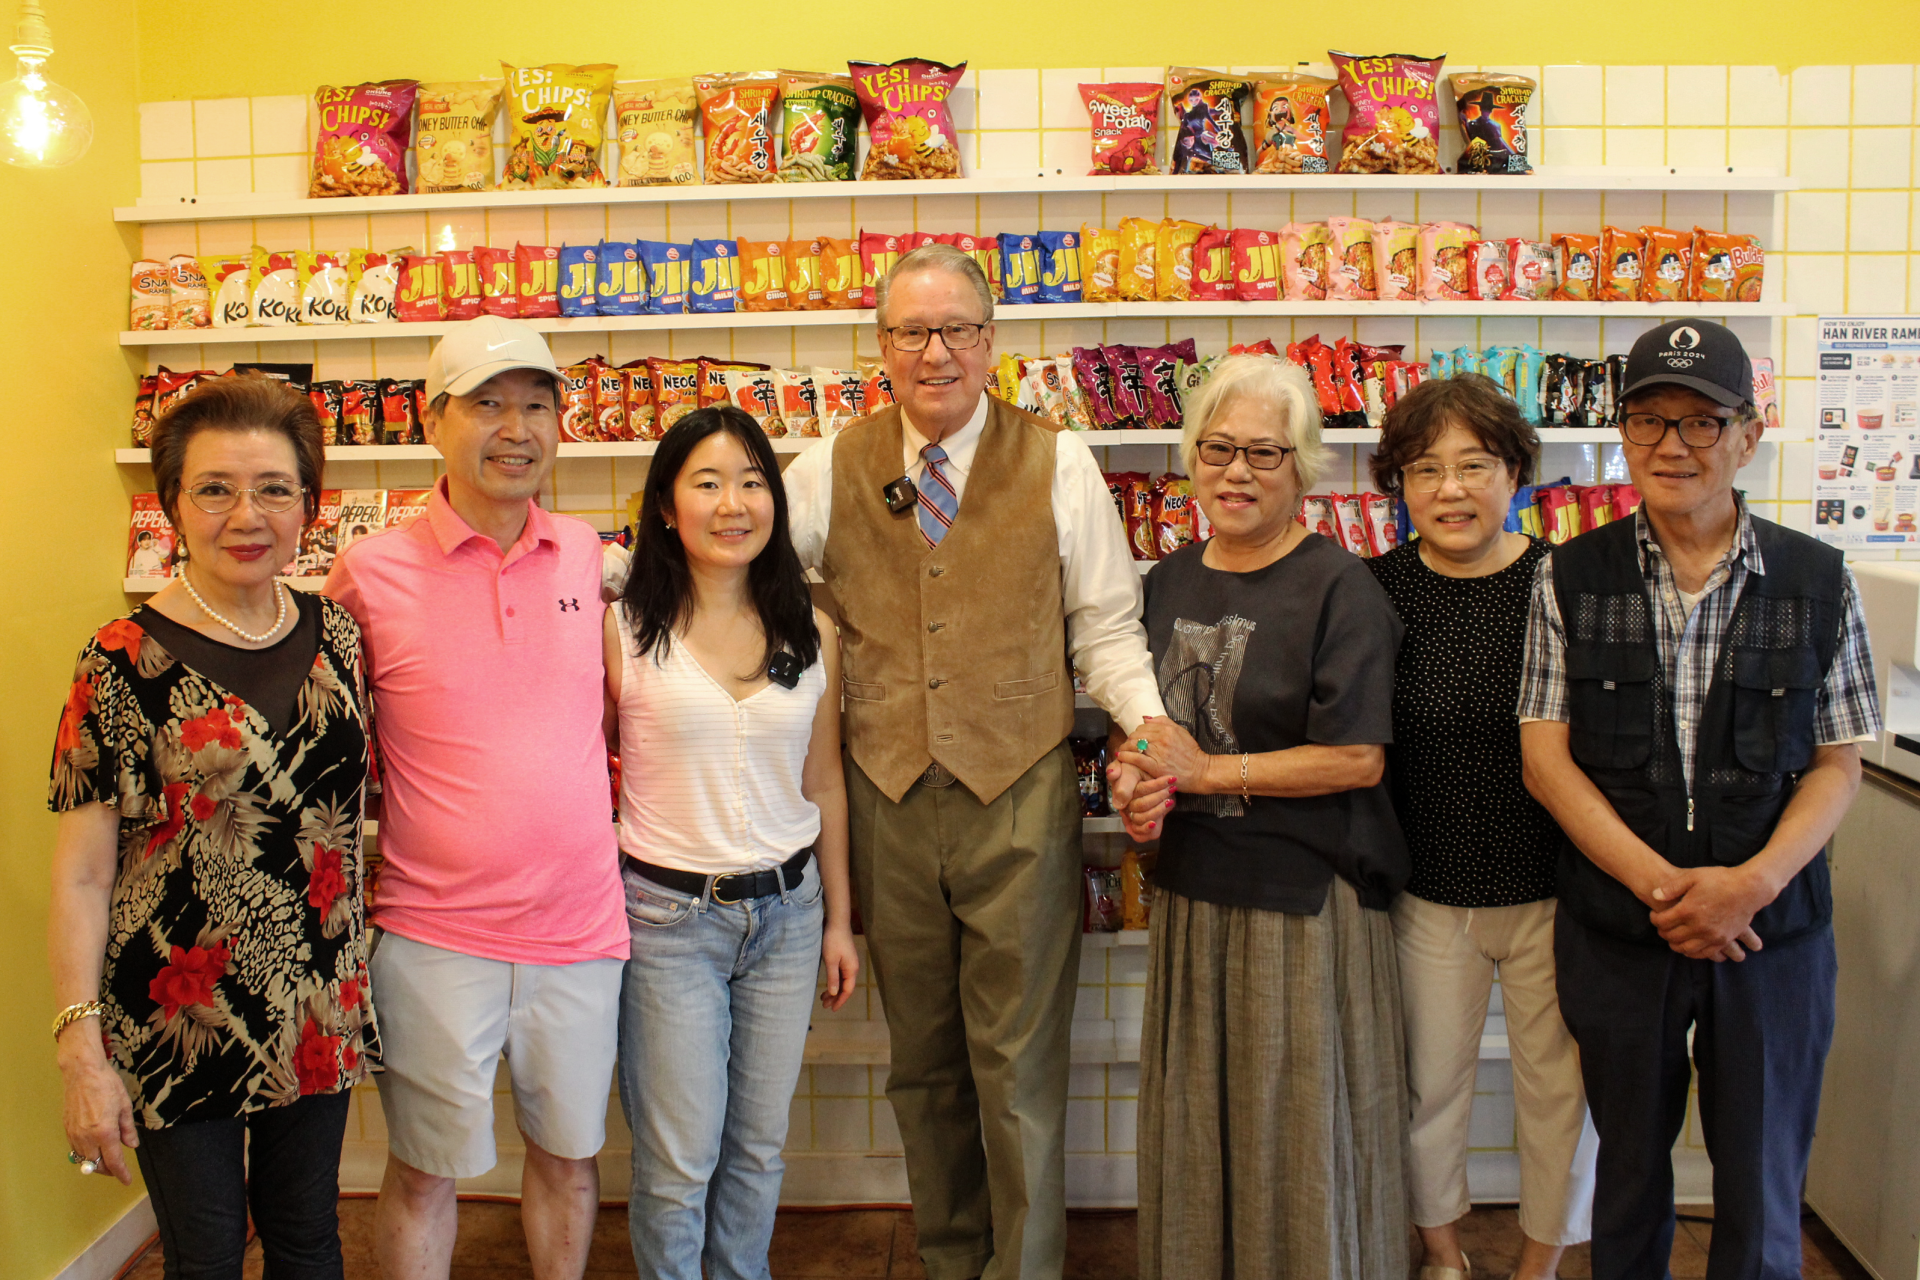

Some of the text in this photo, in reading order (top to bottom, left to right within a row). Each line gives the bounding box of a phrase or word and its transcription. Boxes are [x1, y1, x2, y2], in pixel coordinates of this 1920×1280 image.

[1341, 58, 1394, 86] YES!
[859, 68, 910, 98] YES!
[1203, 88, 1234, 97] CRACKE
[1209, 80, 1243, 90] SHRIMP
[1367, 76, 1435, 102] CHIPS!
[739, 88, 772, 99] SHRIMP
[785, 89, 822, 99] SHRIMP
[882, 84, 950, 112] CHIPS!
[322, 104, 391, 132] CHIPS!
[641, 110, 673, 124] BUTTER
[1089, 99, 1138, 117] Sweet
[440, 116, 469, 131] BUTTER
[1094, 128, 1122, 137] Snack
[1103, 113, 1152, 133] Potato
[1215, 97, 1234, 149] 새우깡
[750, 108, 769, 171] 새우깡
[1043, 247, 1080, 287] JI
[1199, 246, 1232, 283] JI
[1731, 246, 1764, 268] Bulda
[177, 270, 206, 283] SNA
[520, 259, 559, 296] JI
[744, 255, 787, 294] JI
[789, 255, 821, 294] JI
[827, 254, 862, 292] JI
[1006, 249, 1041, 288] JI
[139, 277, 168, 289] SNA
[448, 263, 481, 298] JI
[484, 262, 515, 297] JI
[561, 263, 597, 298] JI
[1063, 283, 1080, 292] MILD
[1215, 283, 1235, 291] SPICY
[1257, 280, 1277, 289] SPICY
[620, 295, 640, 303] MILD
[662, 294, 682, 303] MILD
[713, 290, 734, 300] MILD
[1021, 286, 1039, 295] MILD
[361, 293, 397, 319] KOK
[581, 297, 596, 306] MIL
[223, 301, 249, 324] KO
[1823, 328, 1848, 340] HAN
[1852, 328, 1888, 340] RIVER
[1683, 351, 1706, 360] 2024
[663, 374, 697, 390] NEOG
[1548, 502, 1581, 545] JI
